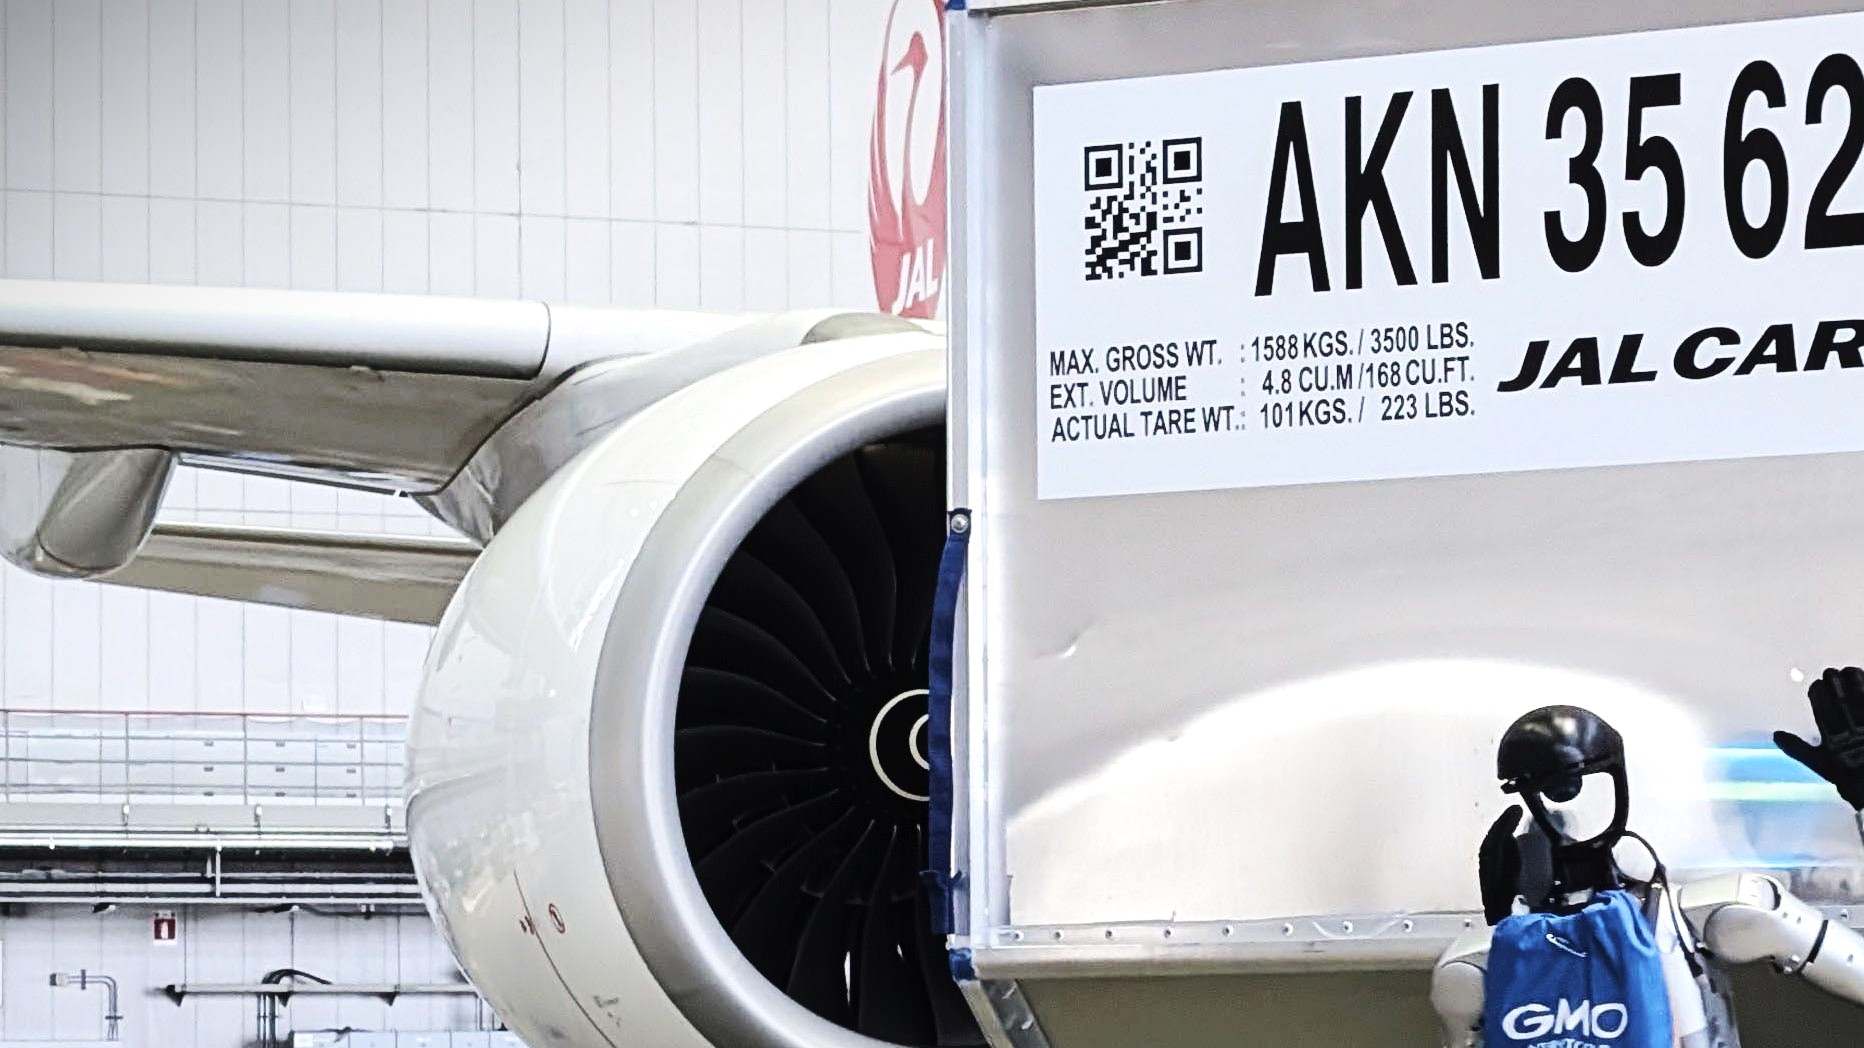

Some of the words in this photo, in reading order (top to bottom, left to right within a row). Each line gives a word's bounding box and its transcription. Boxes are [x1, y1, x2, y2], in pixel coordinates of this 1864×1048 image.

[1254, 84, 1500, 297] AKN
[1544, 72, 1686, 272] 35
[891, 237, 940, 316] JAL
[1050, 348, 1099, 377] MAX.
[1106, 342, 1180, 373] GROSS
[1185, 339, 1223, 367] WT.
[1251, 334, 1298, 362] 1588
[1303, 329, 1354, 358] KGS.
[1371, 325, 1419, 354] 3500
[1427, 321, 1474, 350] LBS.
[1497, 332, 1658, 393] JAL
[1050, 382, 1095, 410] EXT.
[1100, 375, 1187, 406] VOLUME
[1262, 368, 1292, 395] 4.8
[1299, 363, 1353, 392] CU.M
[1406, 355, 1475, 386] CU.FT.
[1051, 411, 1135, 443] ACTUAL
[1140, 407, 1197, 437] TARE
[1260, 401, 1293, 429] 101
[1299, 398, 1352, 427] KGS.
[1381, 394, 1418, 421] 223
[1425, 390, 1475, 419] LBS.
[1501, 998, 1628, 1040] GMO
